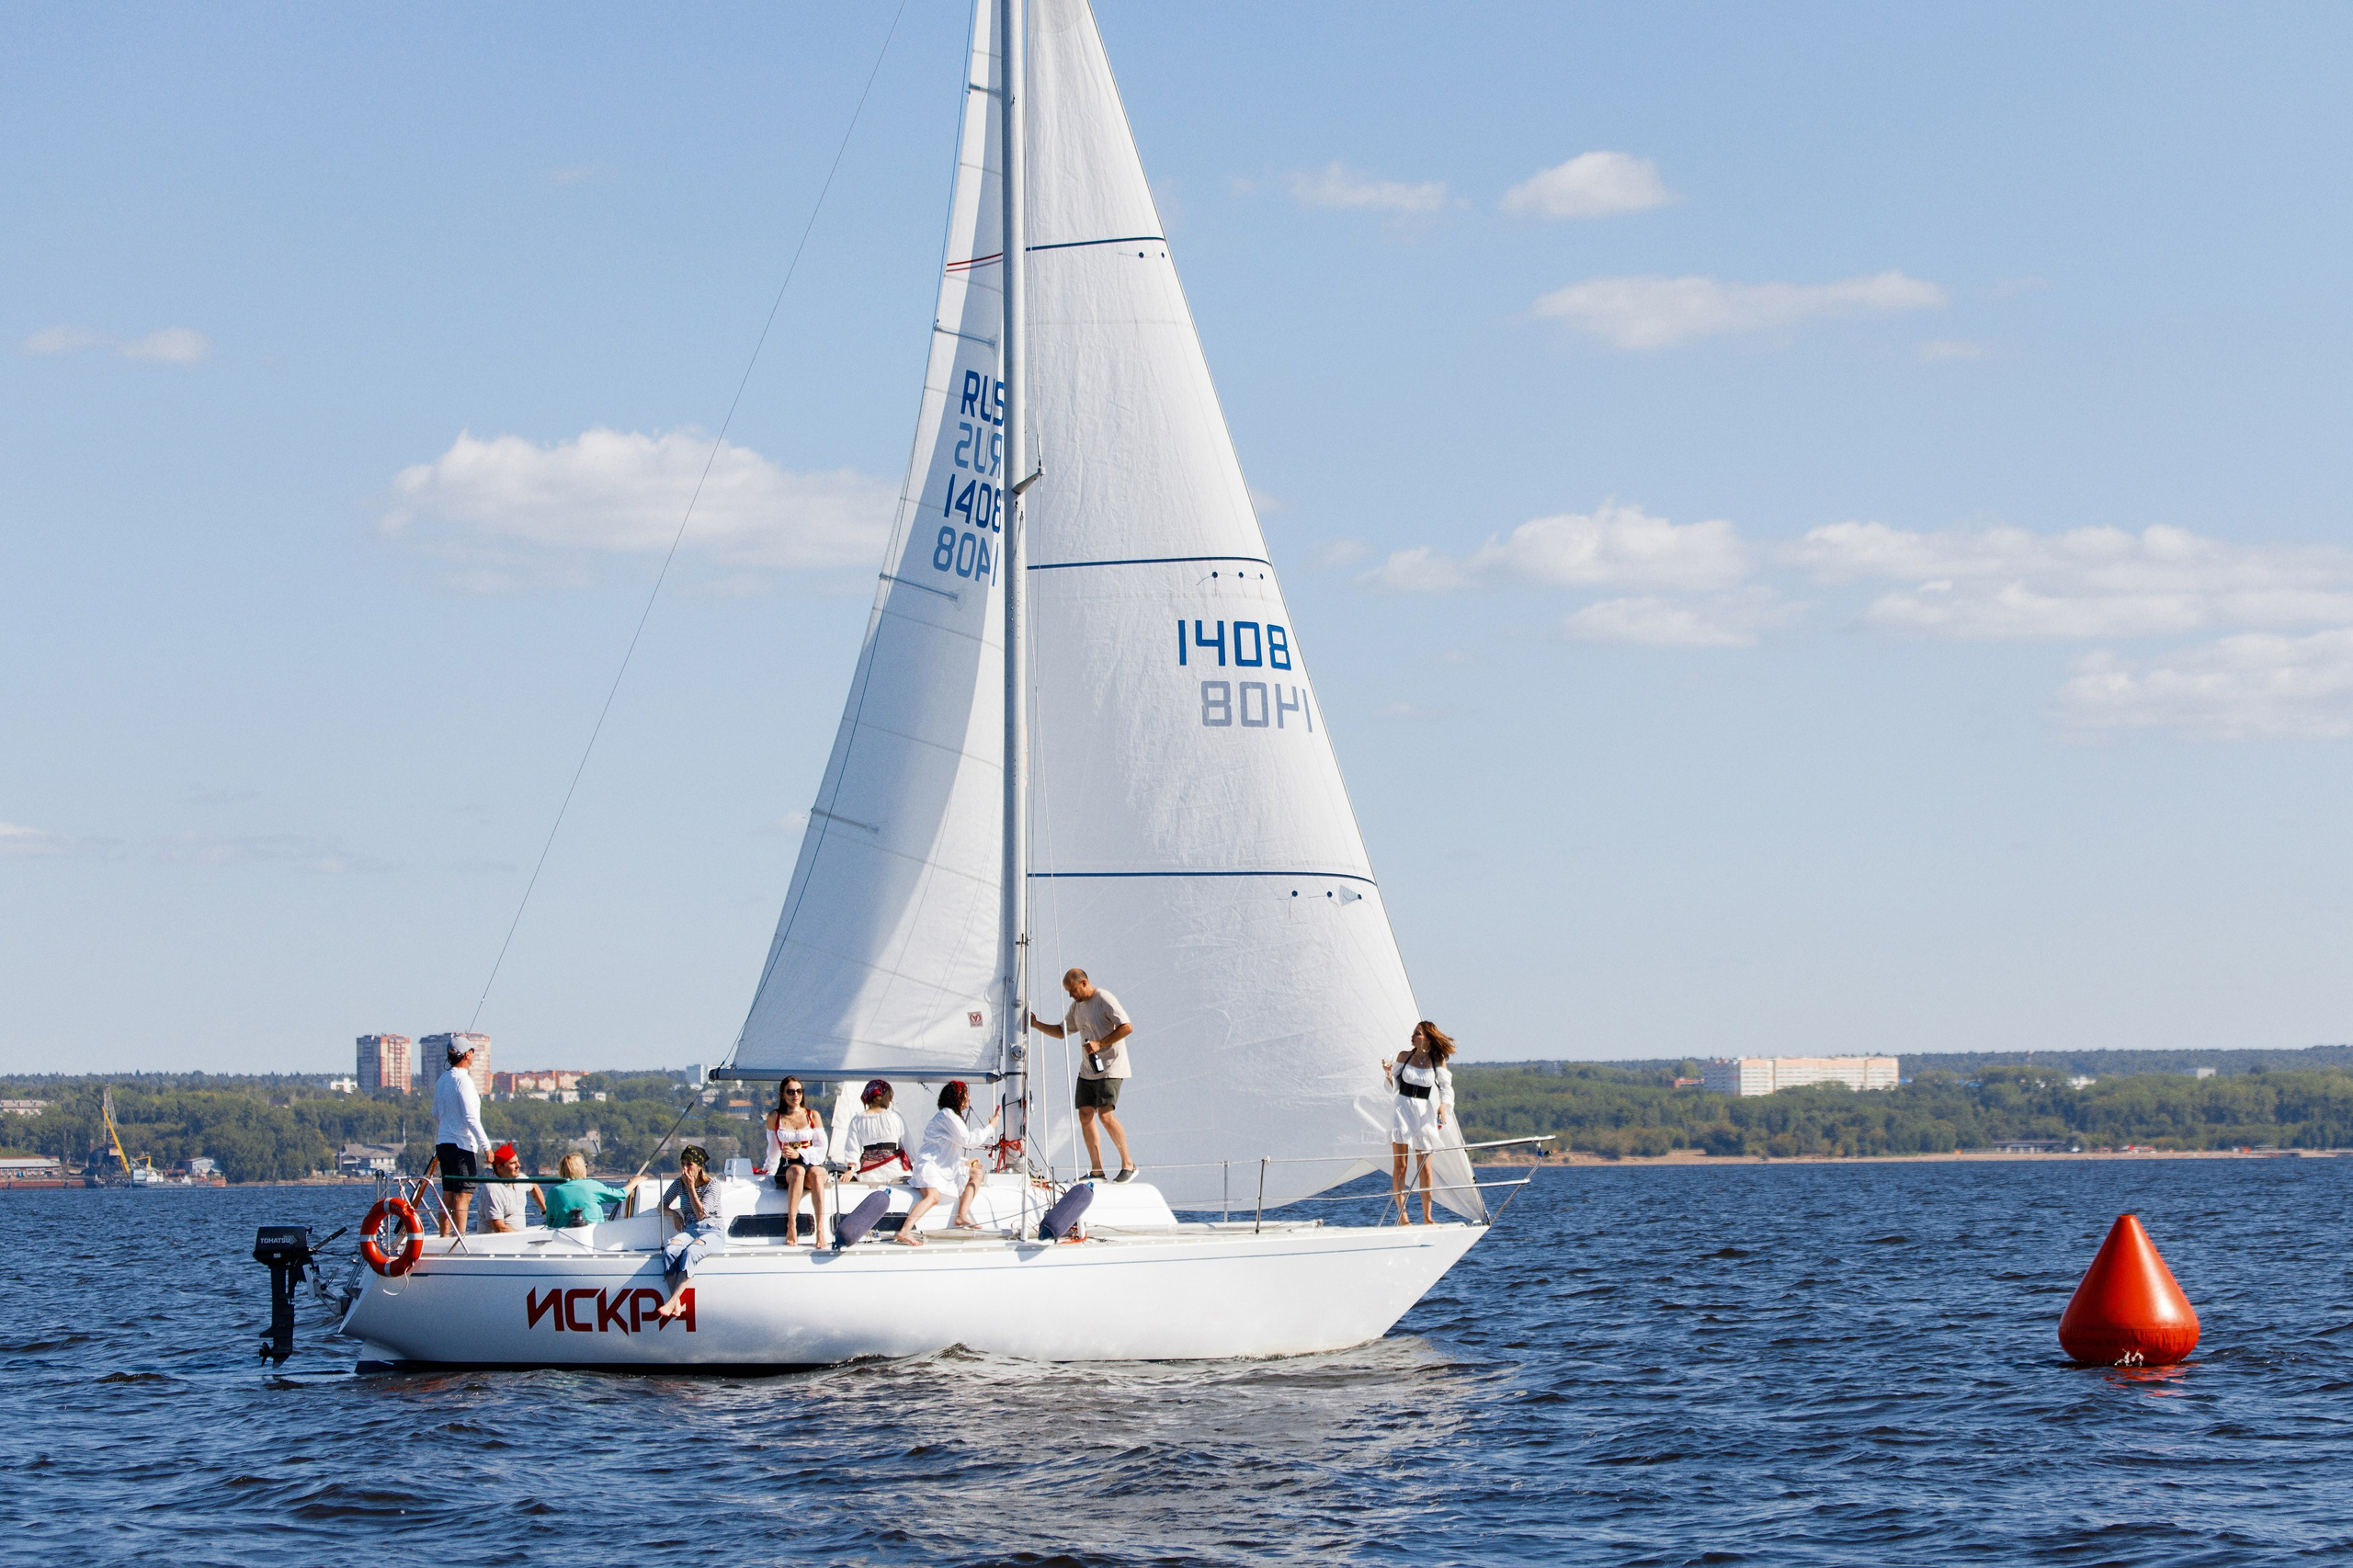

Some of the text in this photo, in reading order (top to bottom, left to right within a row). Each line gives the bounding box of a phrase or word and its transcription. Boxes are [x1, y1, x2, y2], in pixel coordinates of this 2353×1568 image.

[961, 369, 1004, 426] RUS
[943, 473, 1002, 533] 1408
[1177, 619, 1291, 671] 1408
[527, 1286, 697, 1336] ИСКРА
